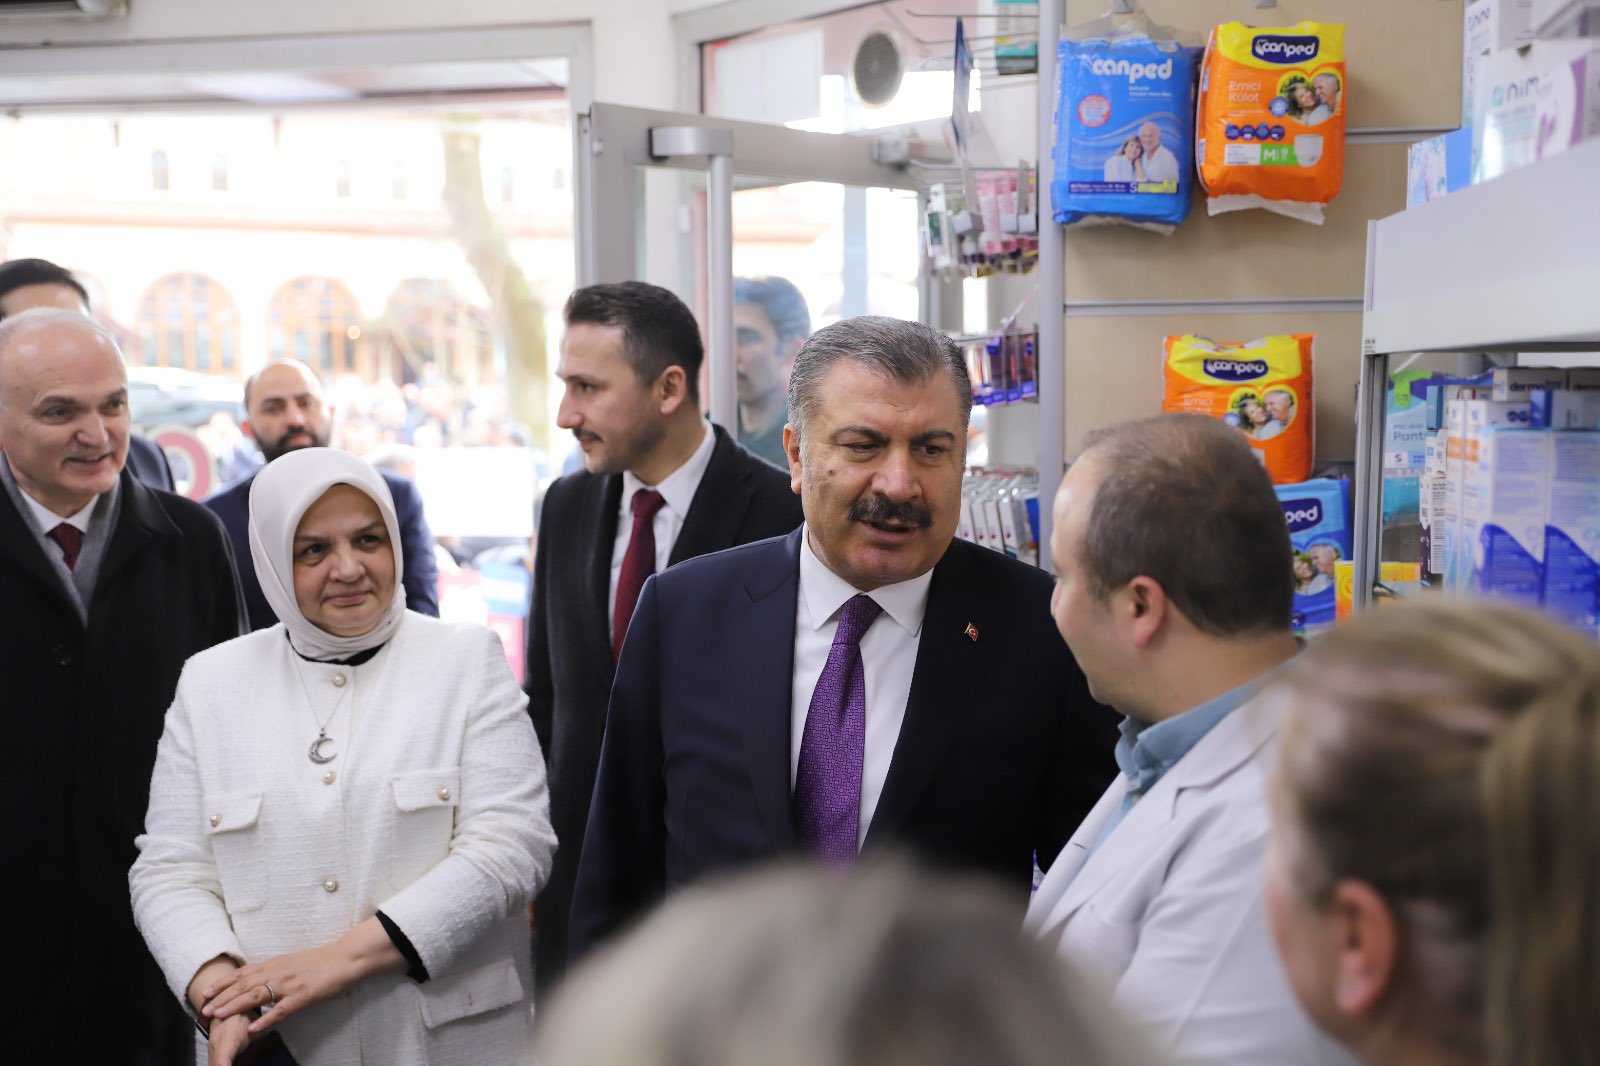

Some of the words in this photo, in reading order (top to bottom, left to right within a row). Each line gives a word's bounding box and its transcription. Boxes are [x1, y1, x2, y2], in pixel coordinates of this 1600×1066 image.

[1256, 40, 1316, 58] canped
[1092, 58, 1172, 83] canped
[1264, 149, 1277, 161] M
[1285, 506, 1318, 526] ped
